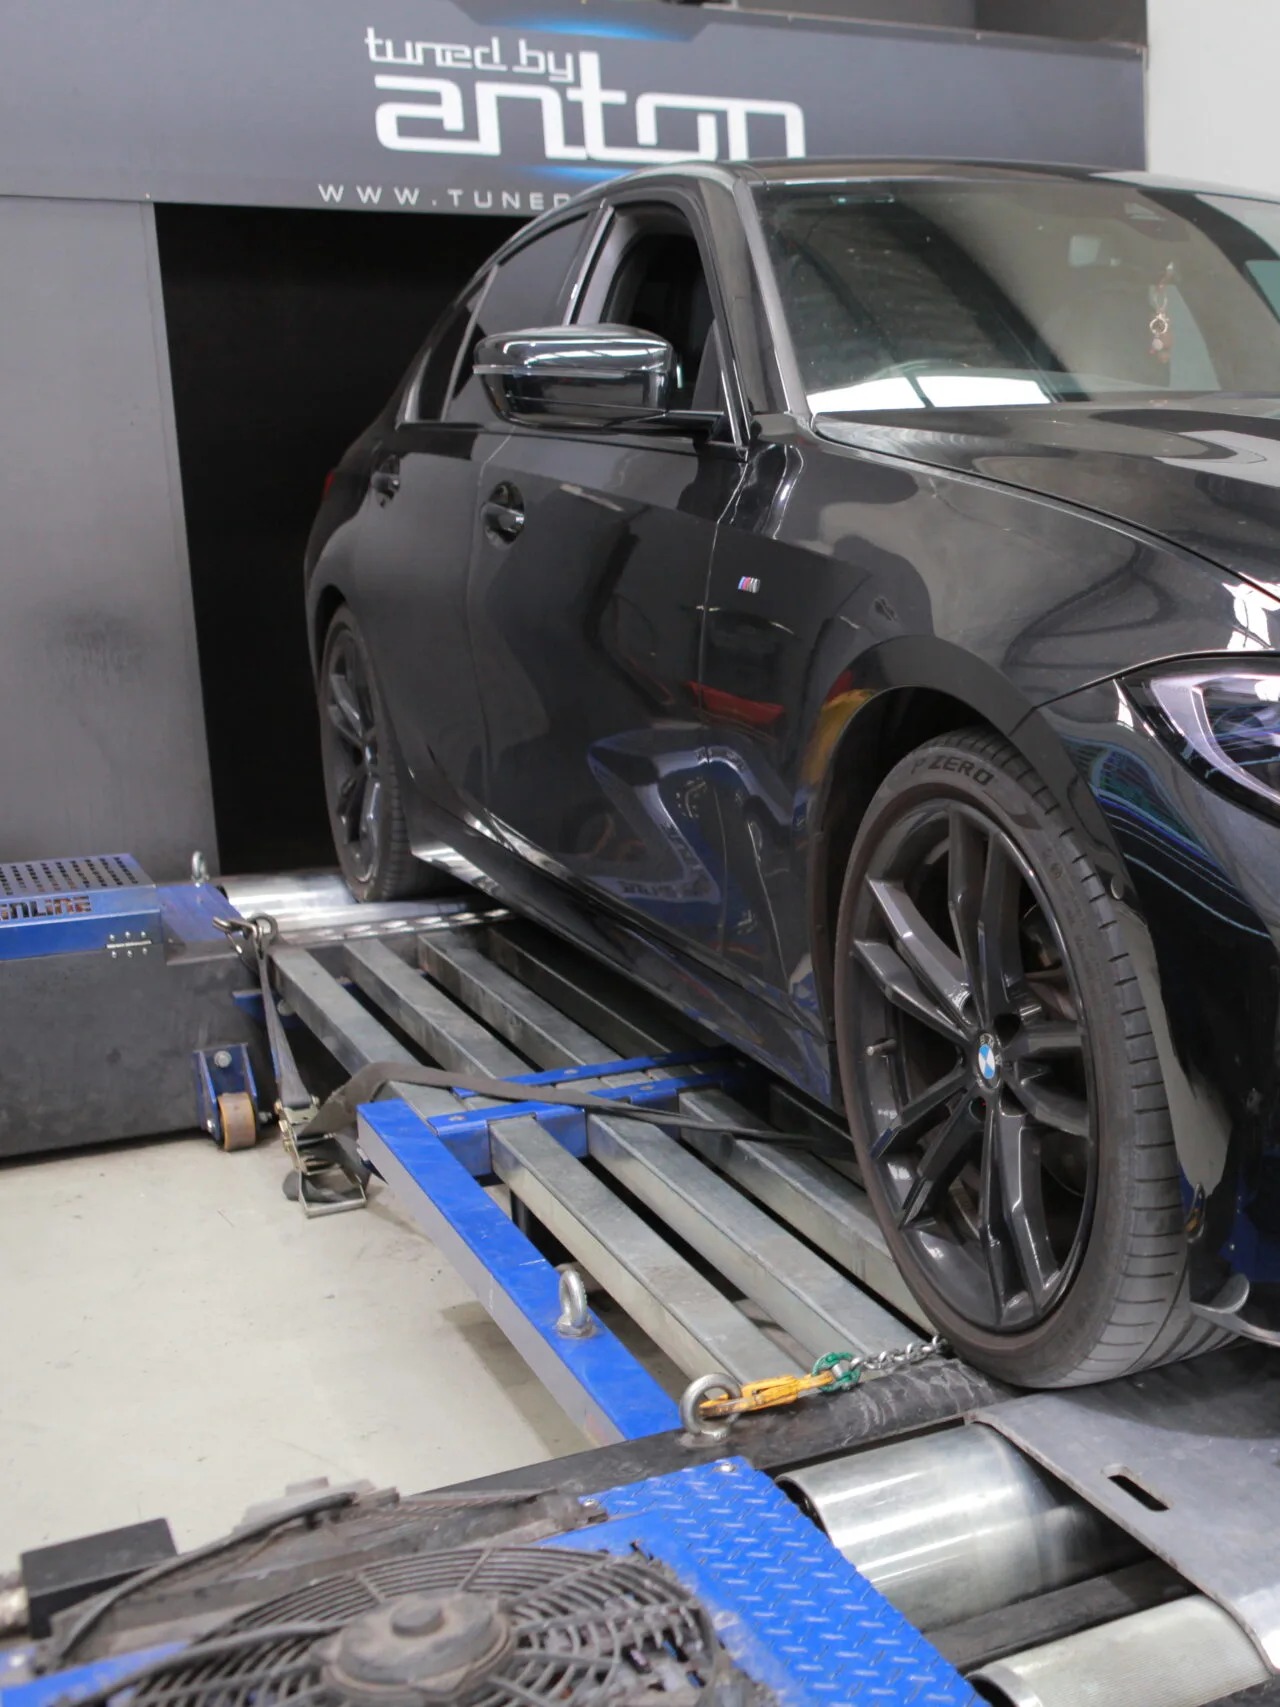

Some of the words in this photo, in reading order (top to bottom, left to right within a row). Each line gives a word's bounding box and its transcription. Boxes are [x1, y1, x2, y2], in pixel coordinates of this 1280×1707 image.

[364, 27, 506, 71] tuned
[512, 39, 574, 82] by
[374, 51, 806, 163] anton
[928, 755, 994, 786] ZERO
